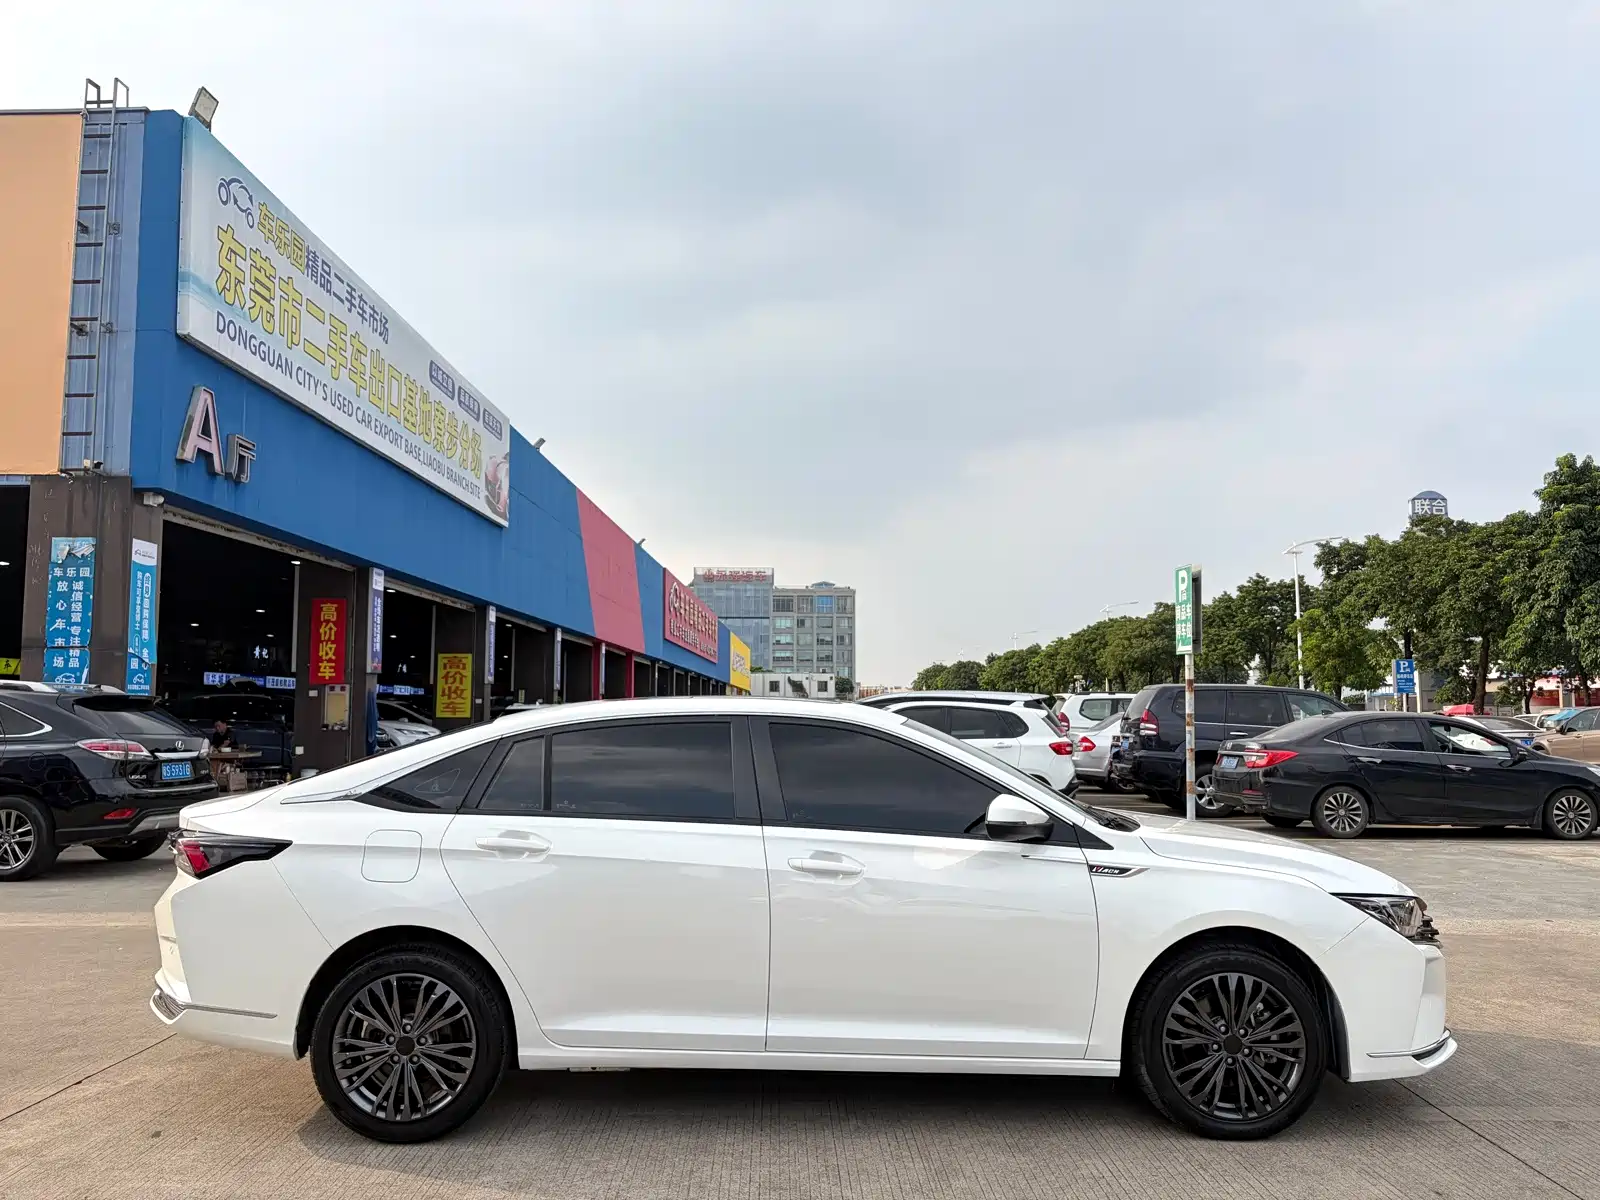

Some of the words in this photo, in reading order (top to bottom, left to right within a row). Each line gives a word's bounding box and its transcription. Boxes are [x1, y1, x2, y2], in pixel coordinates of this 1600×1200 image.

[258, 202, 390, 344] 车乐园精品二手车市场
[216, 224, 481, 479] 东莞市二手车出口基地寮步分场
[216, 310, 293, 380] DONGGUAN
[296, 366, 328, 401] CITY'S
[330, 387, 354, 418] USED
[355, 406, 373, 432] CAR
[374, 417, 404, 450] EXPORT
[446, 466, 470, 492] BRANCH
[469, 483, 481, 500] SITE
[1414, 498, 1446, 515] 联合
[53, 567, 90, 578] 车乐园
[318, 603, 338, 680] 高价收车
[441, 655, 468, 716] 高价收车
